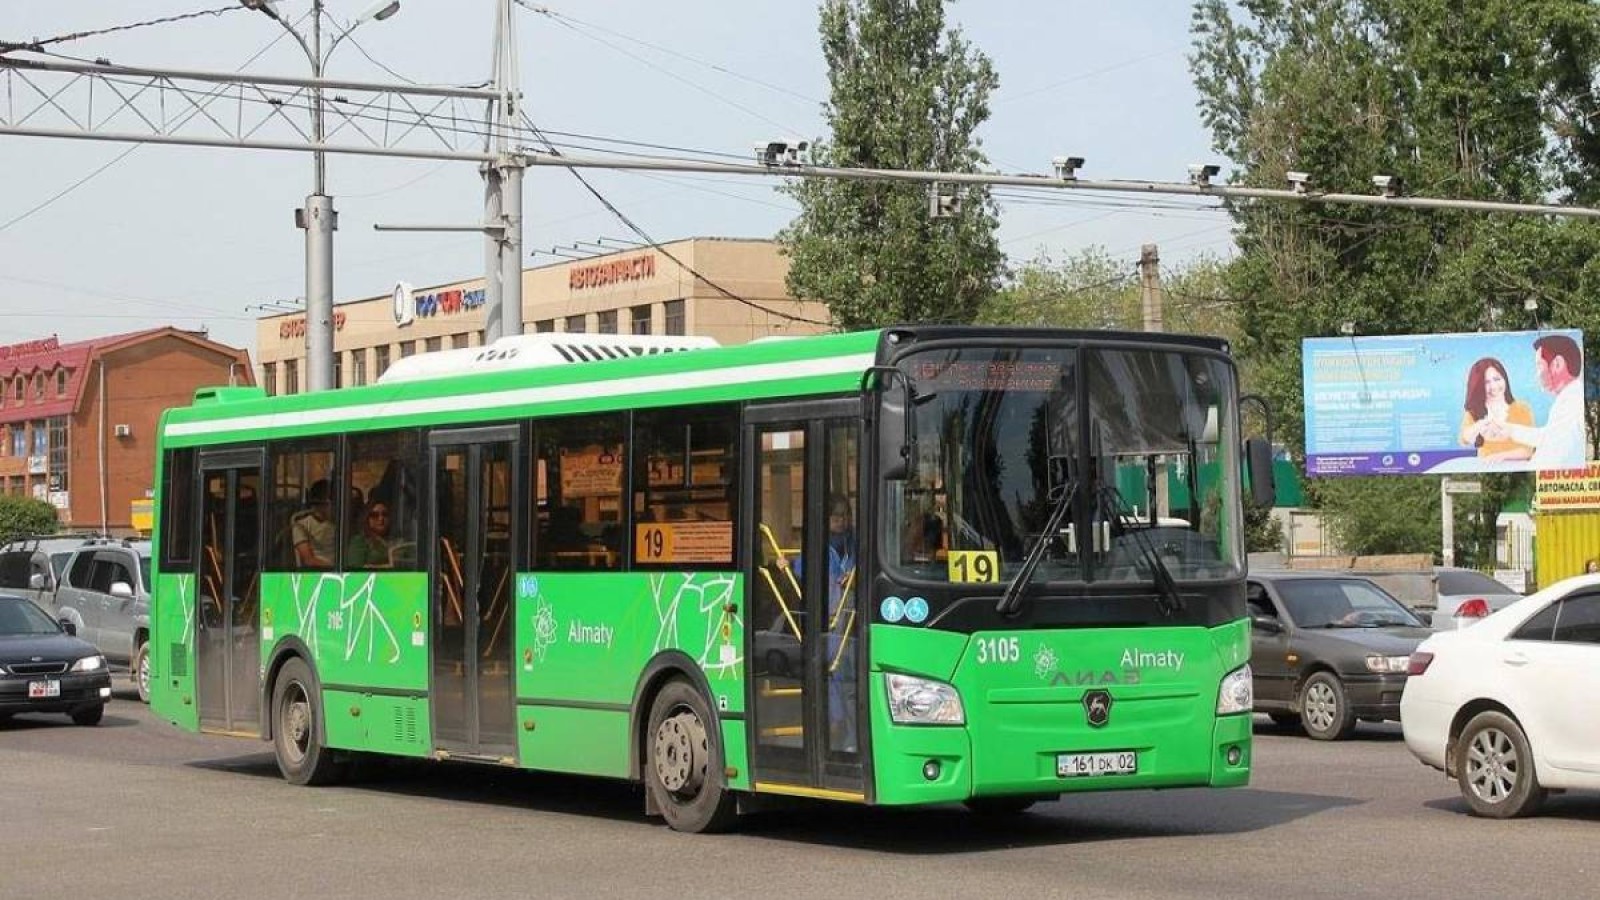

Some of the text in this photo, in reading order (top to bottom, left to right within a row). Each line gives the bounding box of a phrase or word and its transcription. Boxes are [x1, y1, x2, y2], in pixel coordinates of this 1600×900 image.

[1539, 463, 1600, 480] АВТОМАГ
[644, 529, 664, 558] 19
[954, 554, 993, 583] 19
[567, 618, 614, 649] Almaty
[977, 636, 1020, 664] 3105
[1120, 647, 1185, 672] Almaty
[1072, 755, 1095, 772] 161
[1099, 757, 1113, 770] DK
[1119, 753, 1134, 769] 02
